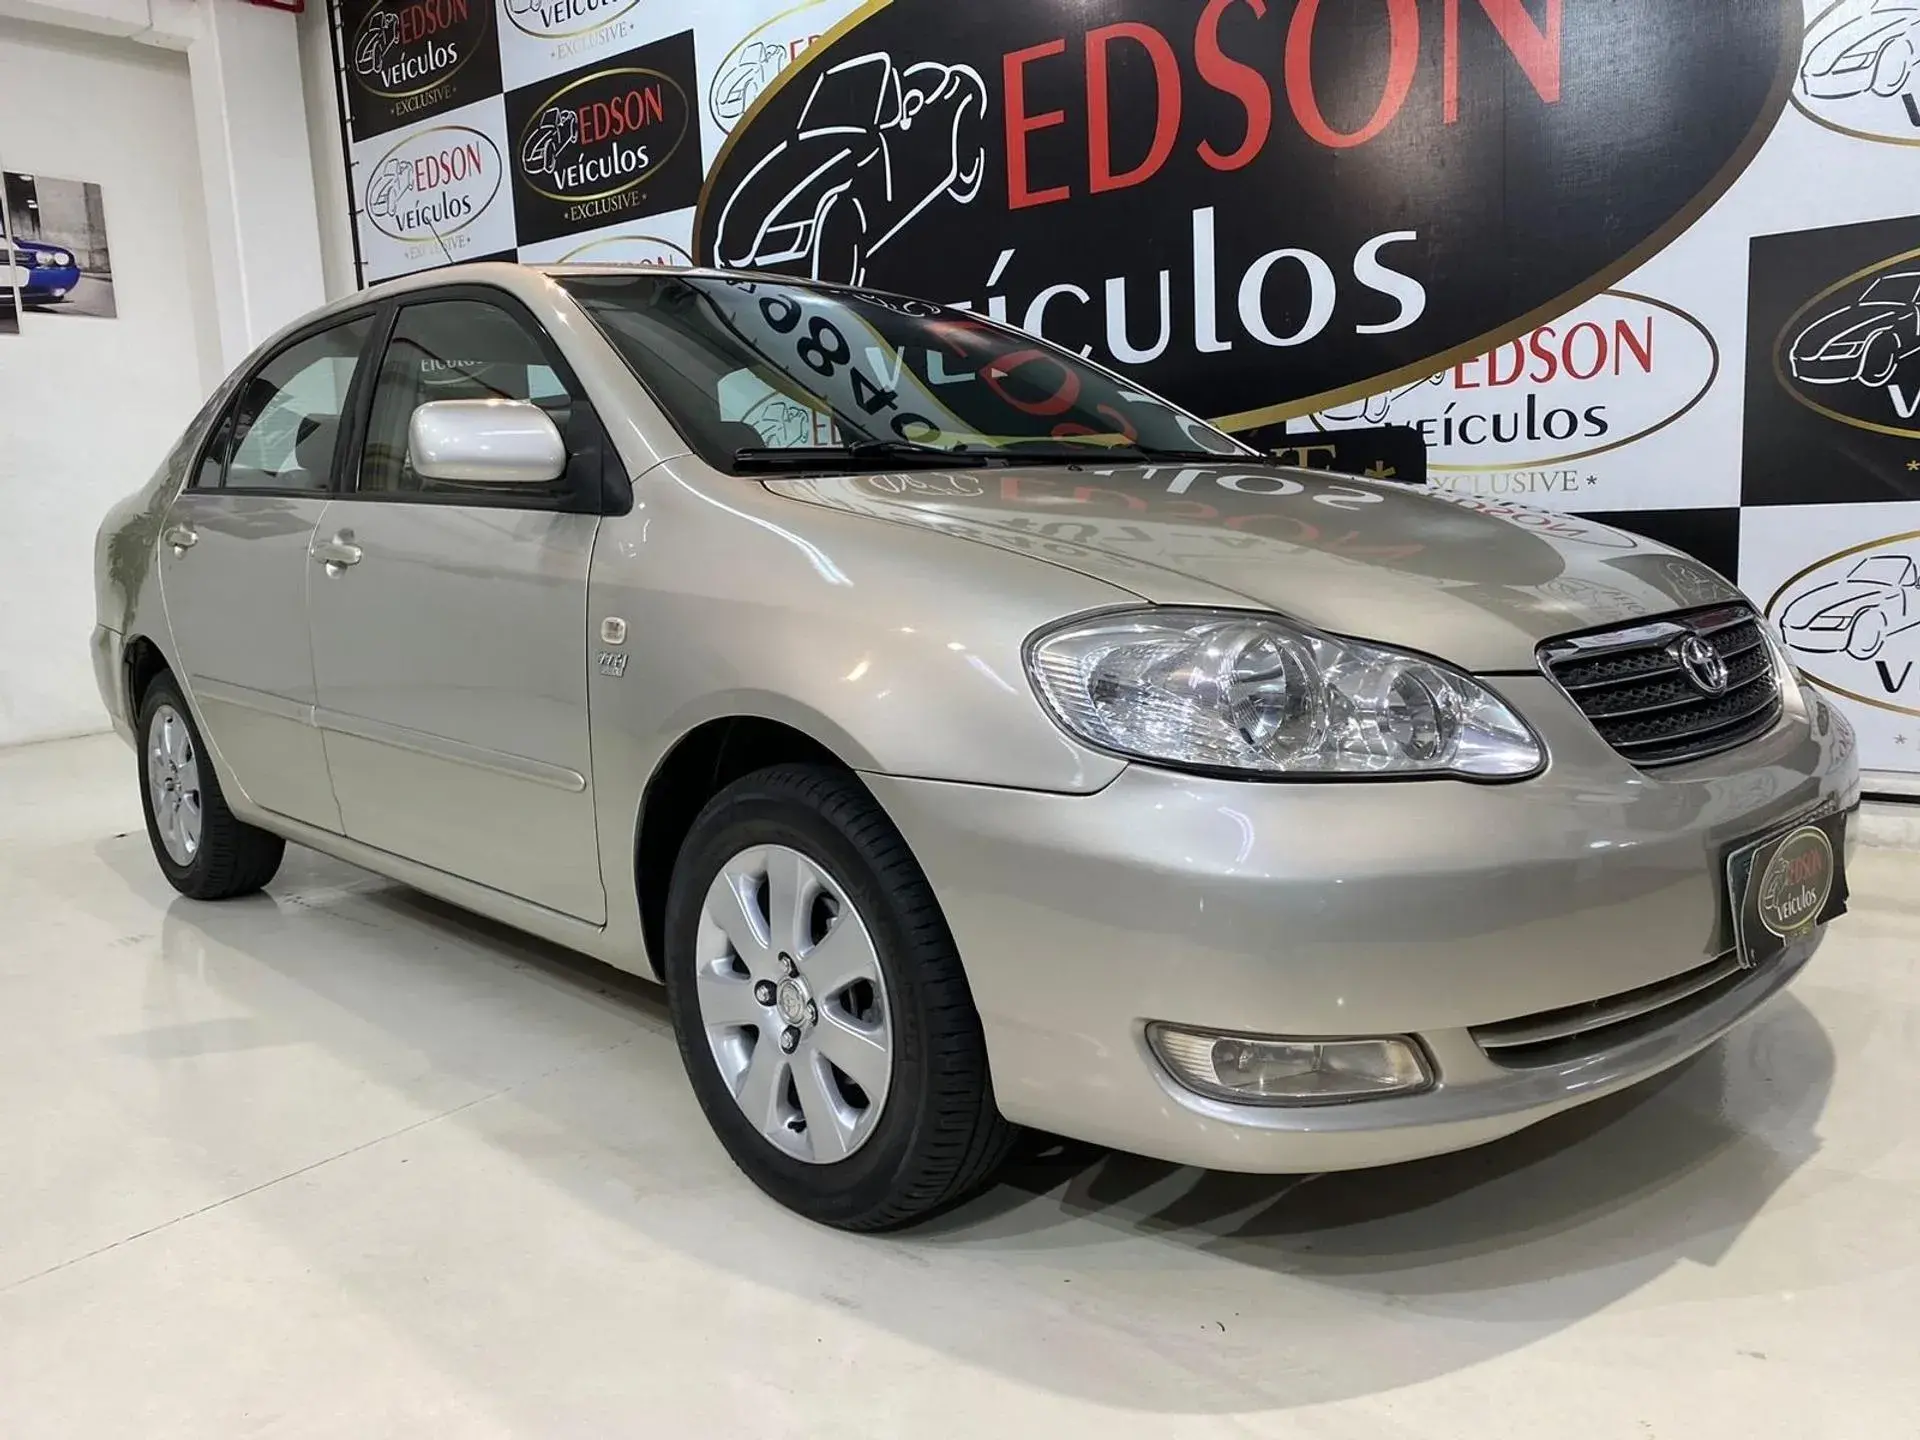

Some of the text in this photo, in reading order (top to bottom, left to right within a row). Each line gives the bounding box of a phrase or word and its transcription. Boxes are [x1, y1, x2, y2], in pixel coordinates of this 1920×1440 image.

[400, 0, 469, 45] EDSON
[579, 84, 663, 145] EDSON
[1003, 0, 1564, 210] EDSON
[414, 141, 482, 192] EDSON
[570, 190, 640, 222] EXCLUSIVE
[1453, 316, 1653, 390] EDSON
[1428, 470, 1580, 495] XCLUSIVE
